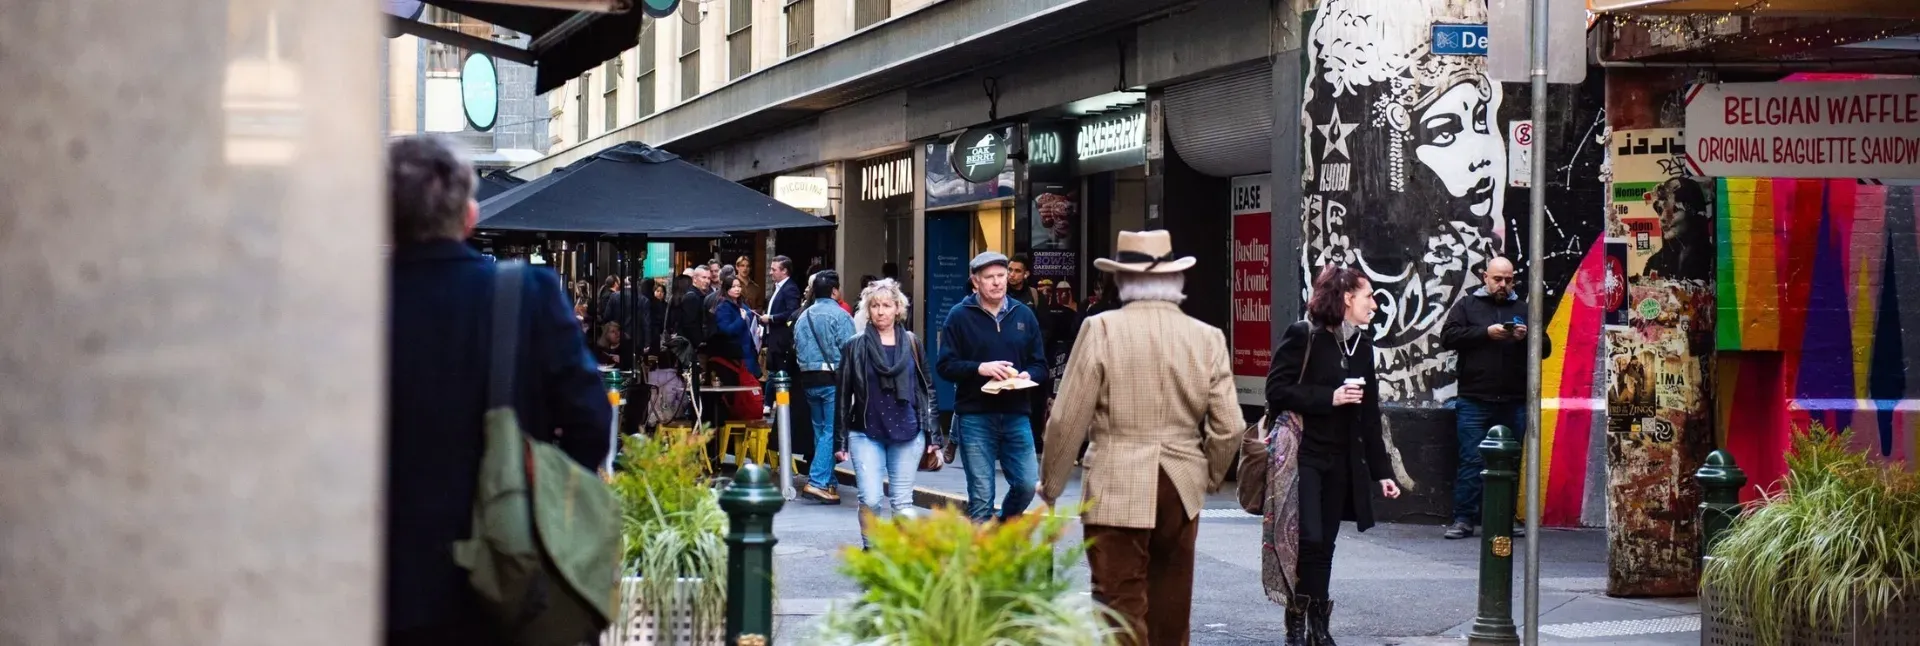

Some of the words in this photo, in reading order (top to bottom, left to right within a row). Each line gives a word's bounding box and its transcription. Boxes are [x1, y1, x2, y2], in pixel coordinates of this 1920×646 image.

[1462, 31, 1488, 48] De
[1724, 95, 1820, 126] BELGIAN
[1827, 93, 1920, 125] WAFFLE
[1077, 113, 1146, 161] OAKBERRY
[966, 153, 996, 163] BERRY
[971, 147, 990, 156] OAK
[1698, 136, 1769, 164] ORIGINAL
[1772, 136, 1857, 165] BAGUETTE
[1861, 136, 1920, 165] SANDW
[779, 180, 824, 197] PICCOLINA
[861, 157, 914, 201] PICCOLINA
[1319, 163, 1351, 192] KYOBI
[1233, 185, 1261, 211] LEASE
[1614, 186, 1647, 199] Women
[1033, 256, 1076, 265] BOWLS
[1235, 238, 1269, 267] Bustling
[1235, 269, 1243, 292] &
[1244, 268, 1269, 292] Iconic
[1629, 403, 1654, 417] ZINGS
